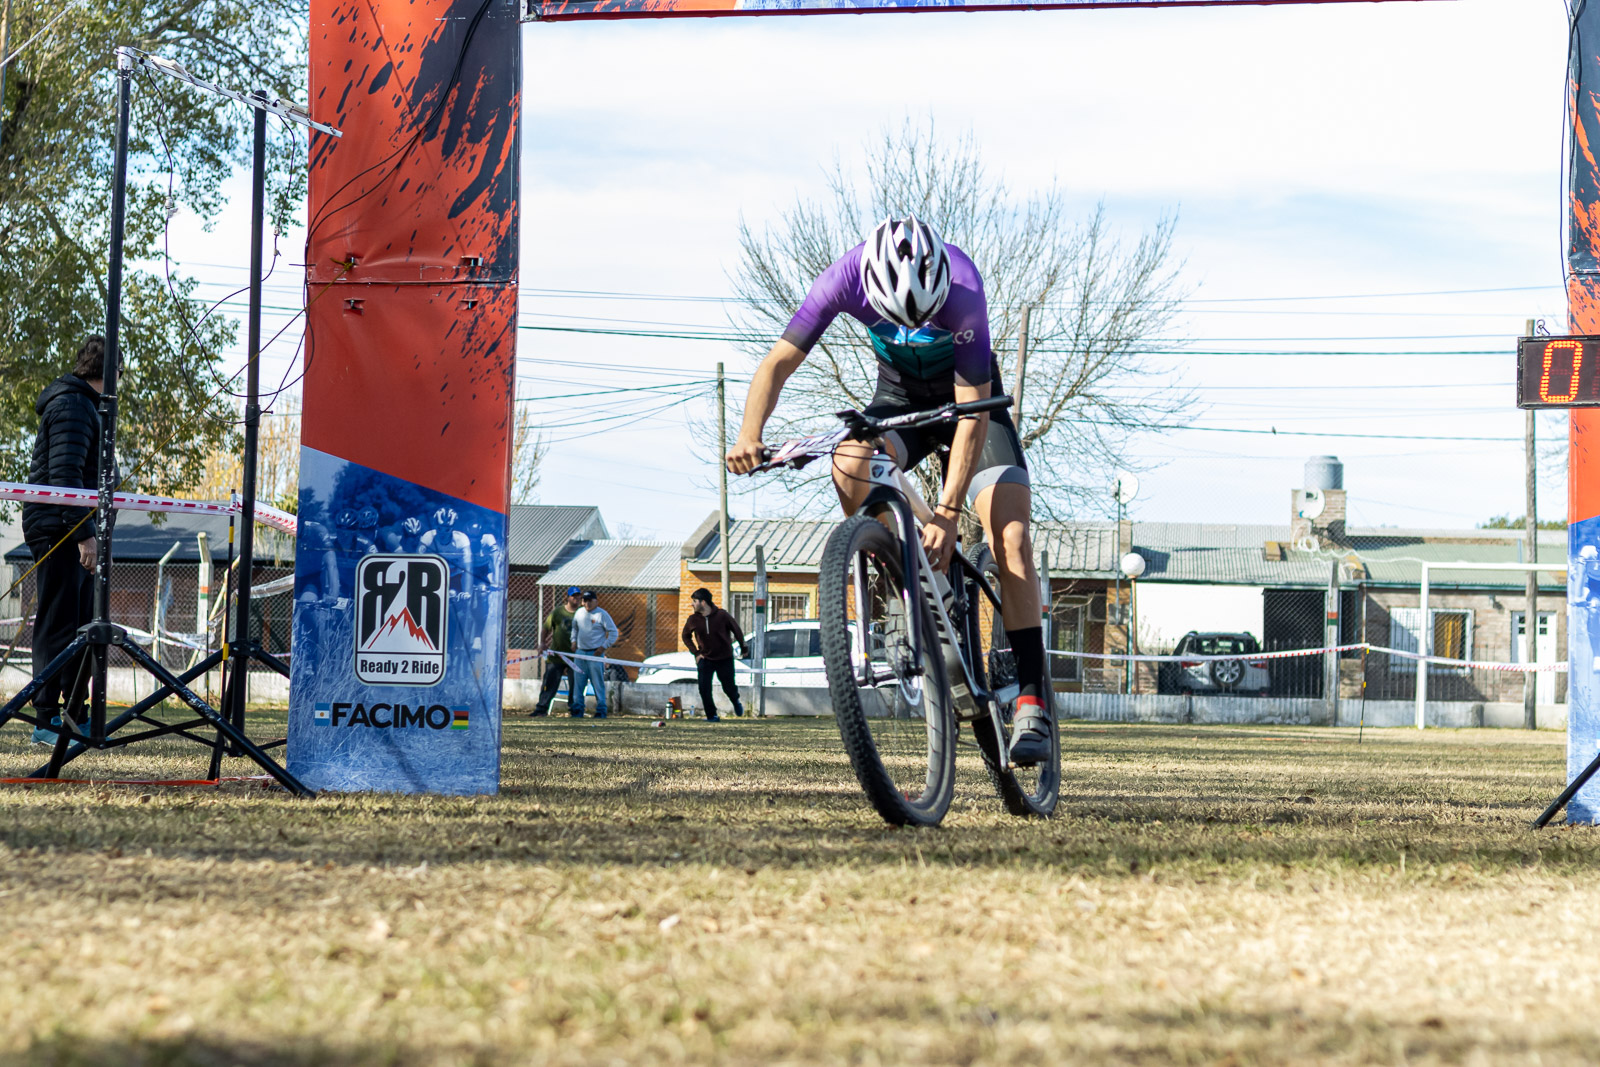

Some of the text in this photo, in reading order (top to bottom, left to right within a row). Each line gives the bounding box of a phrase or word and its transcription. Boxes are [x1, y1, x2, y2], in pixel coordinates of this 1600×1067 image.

[1540, 340, 1583, 403] 0
[361, 659, 439, 674] Ready 2 Ride
[332, 703, 450, 730] FACIMO
